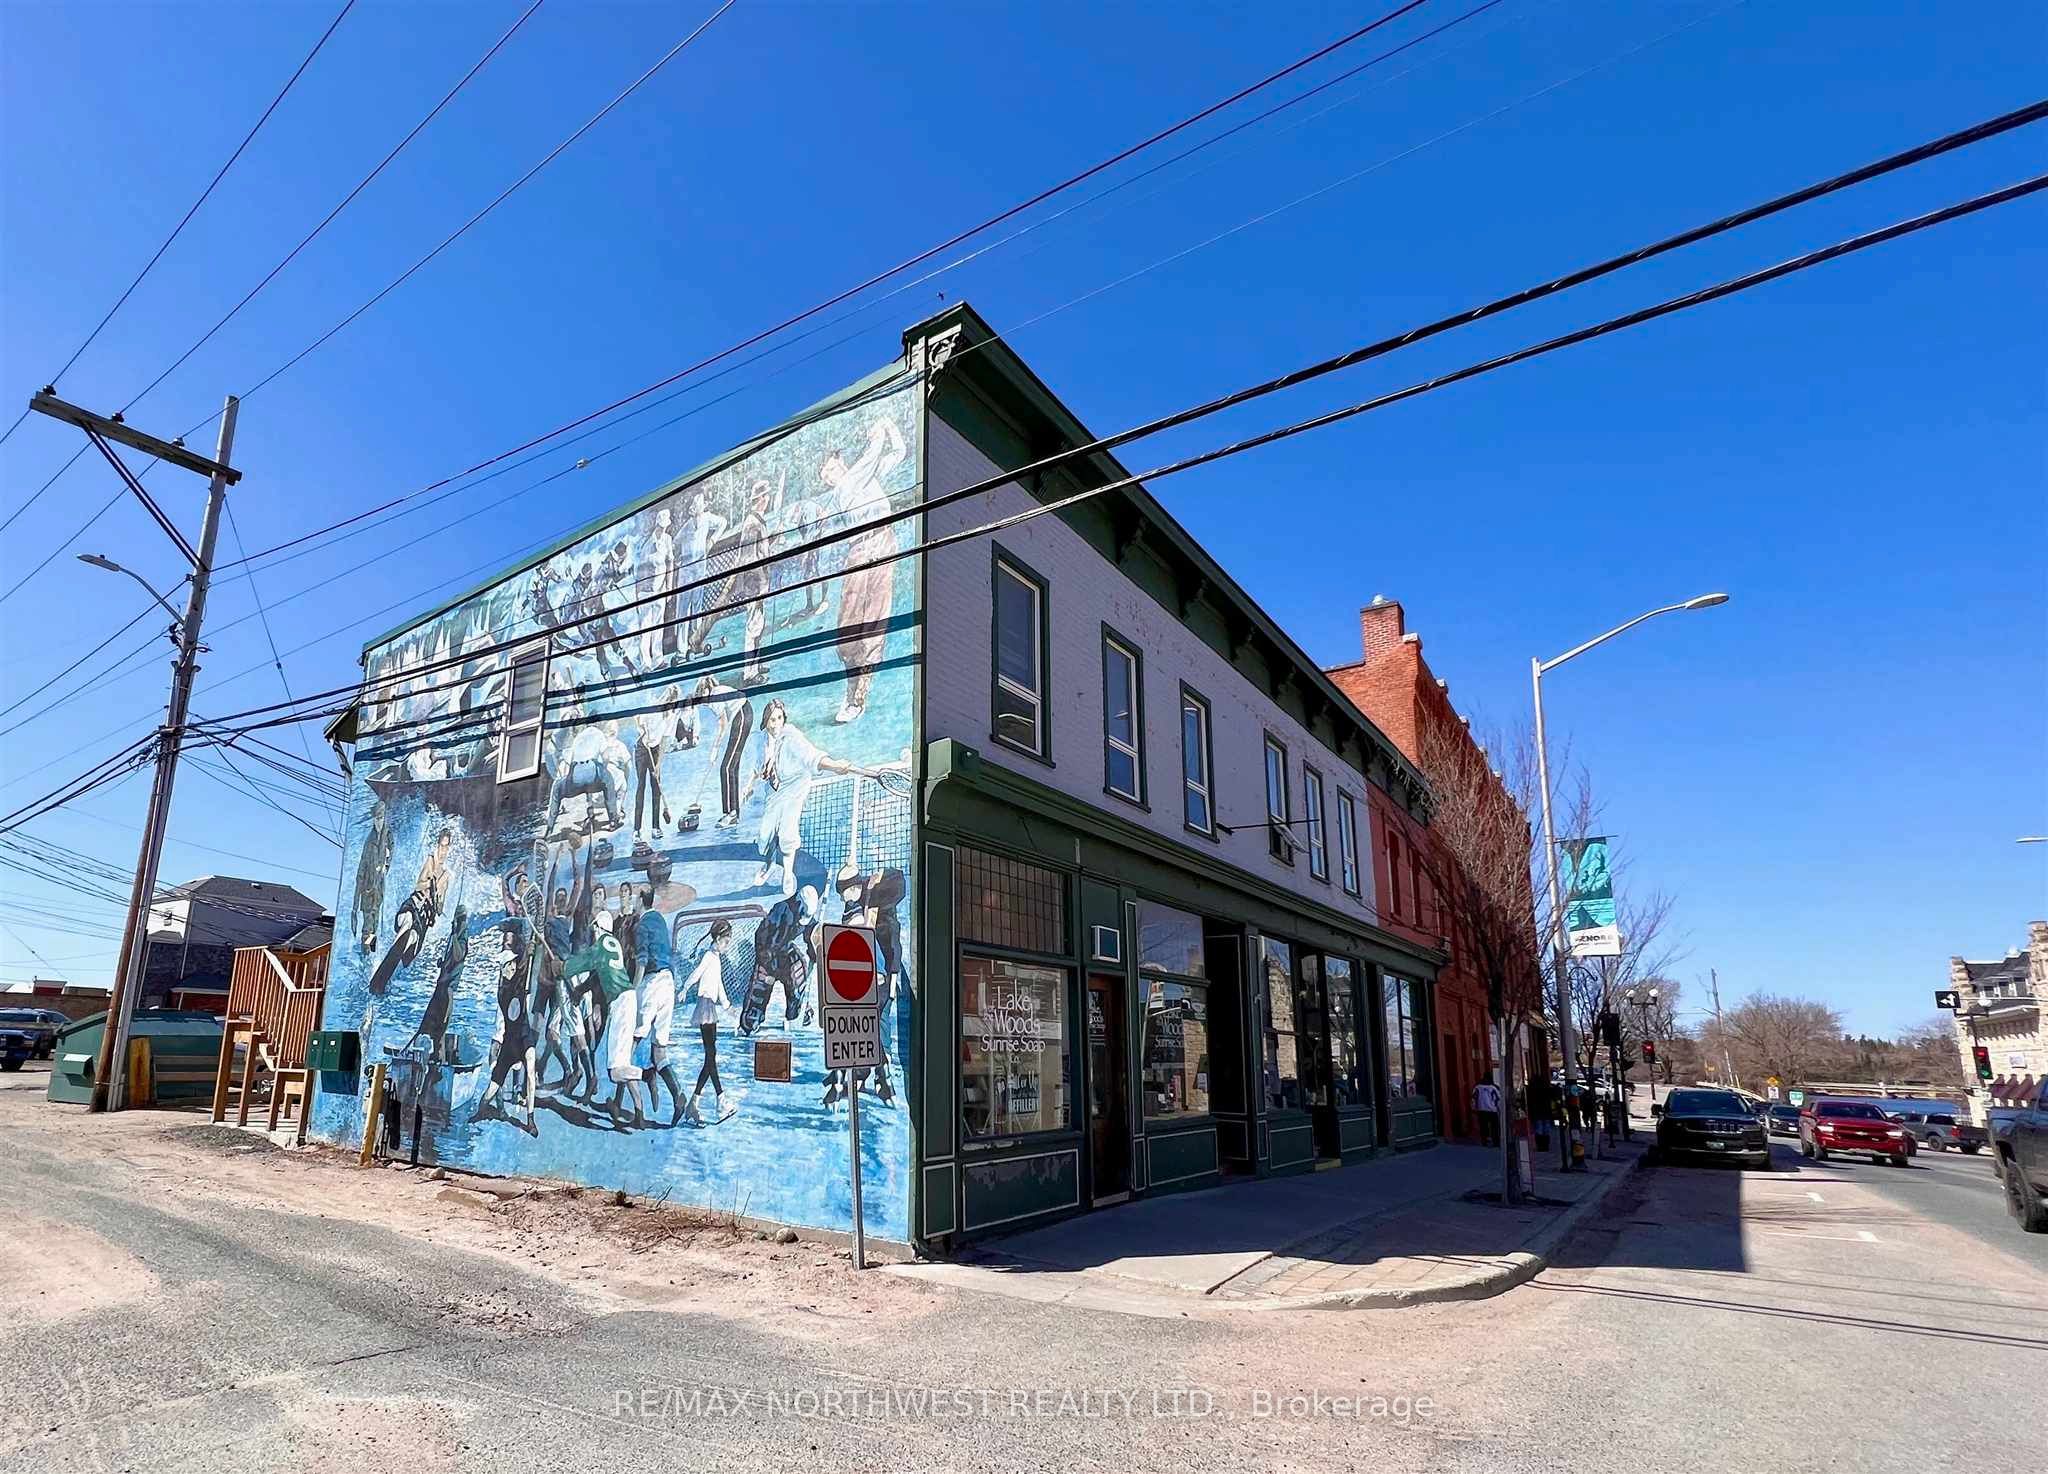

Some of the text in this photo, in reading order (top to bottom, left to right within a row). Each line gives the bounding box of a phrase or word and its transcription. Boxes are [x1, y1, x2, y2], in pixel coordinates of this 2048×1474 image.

[602, 935, 624, 970] 9
[997, 979, 1032, 1012] Lake
[994, 1002, 1041, 1034] Woods
[832, 1041, 875, 1060] ENTER
[1020, 1034, 1046, 1052] Soap
